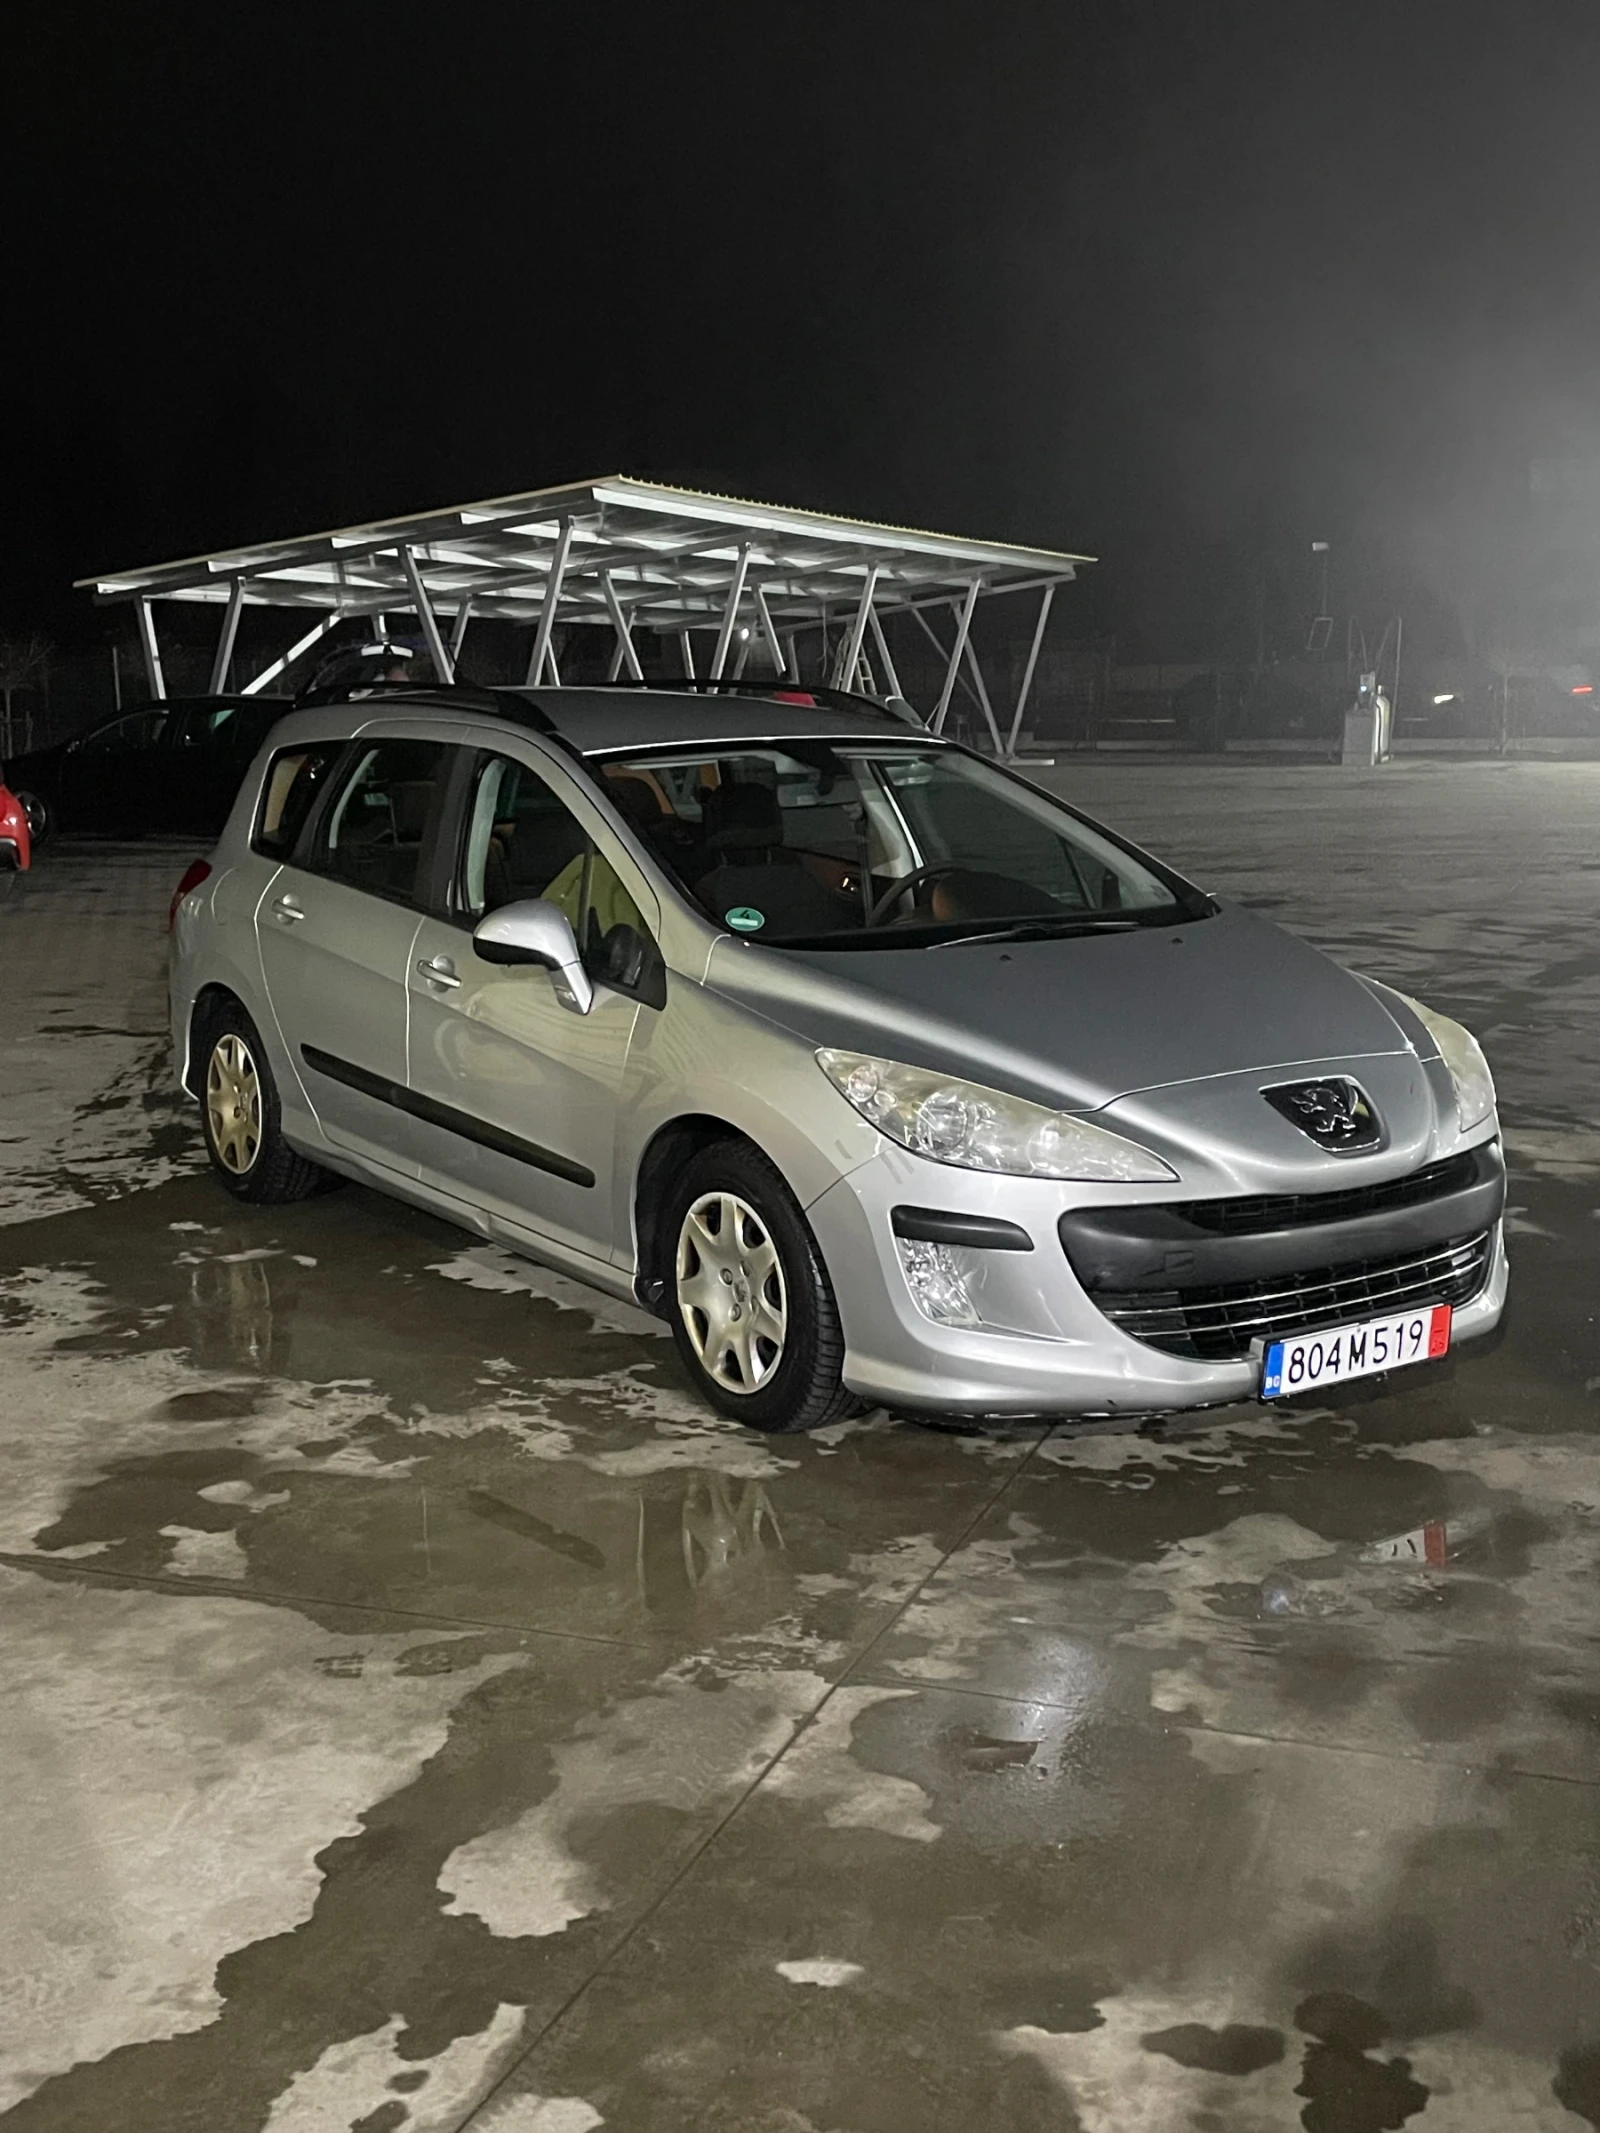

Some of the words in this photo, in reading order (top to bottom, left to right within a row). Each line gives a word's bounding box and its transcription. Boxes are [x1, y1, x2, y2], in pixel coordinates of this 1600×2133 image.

[740, 909, 750, 920] 4
[1288, 1320, 1424, 1384] 804M519
[1265, 1375, 1281, 1389] BG
